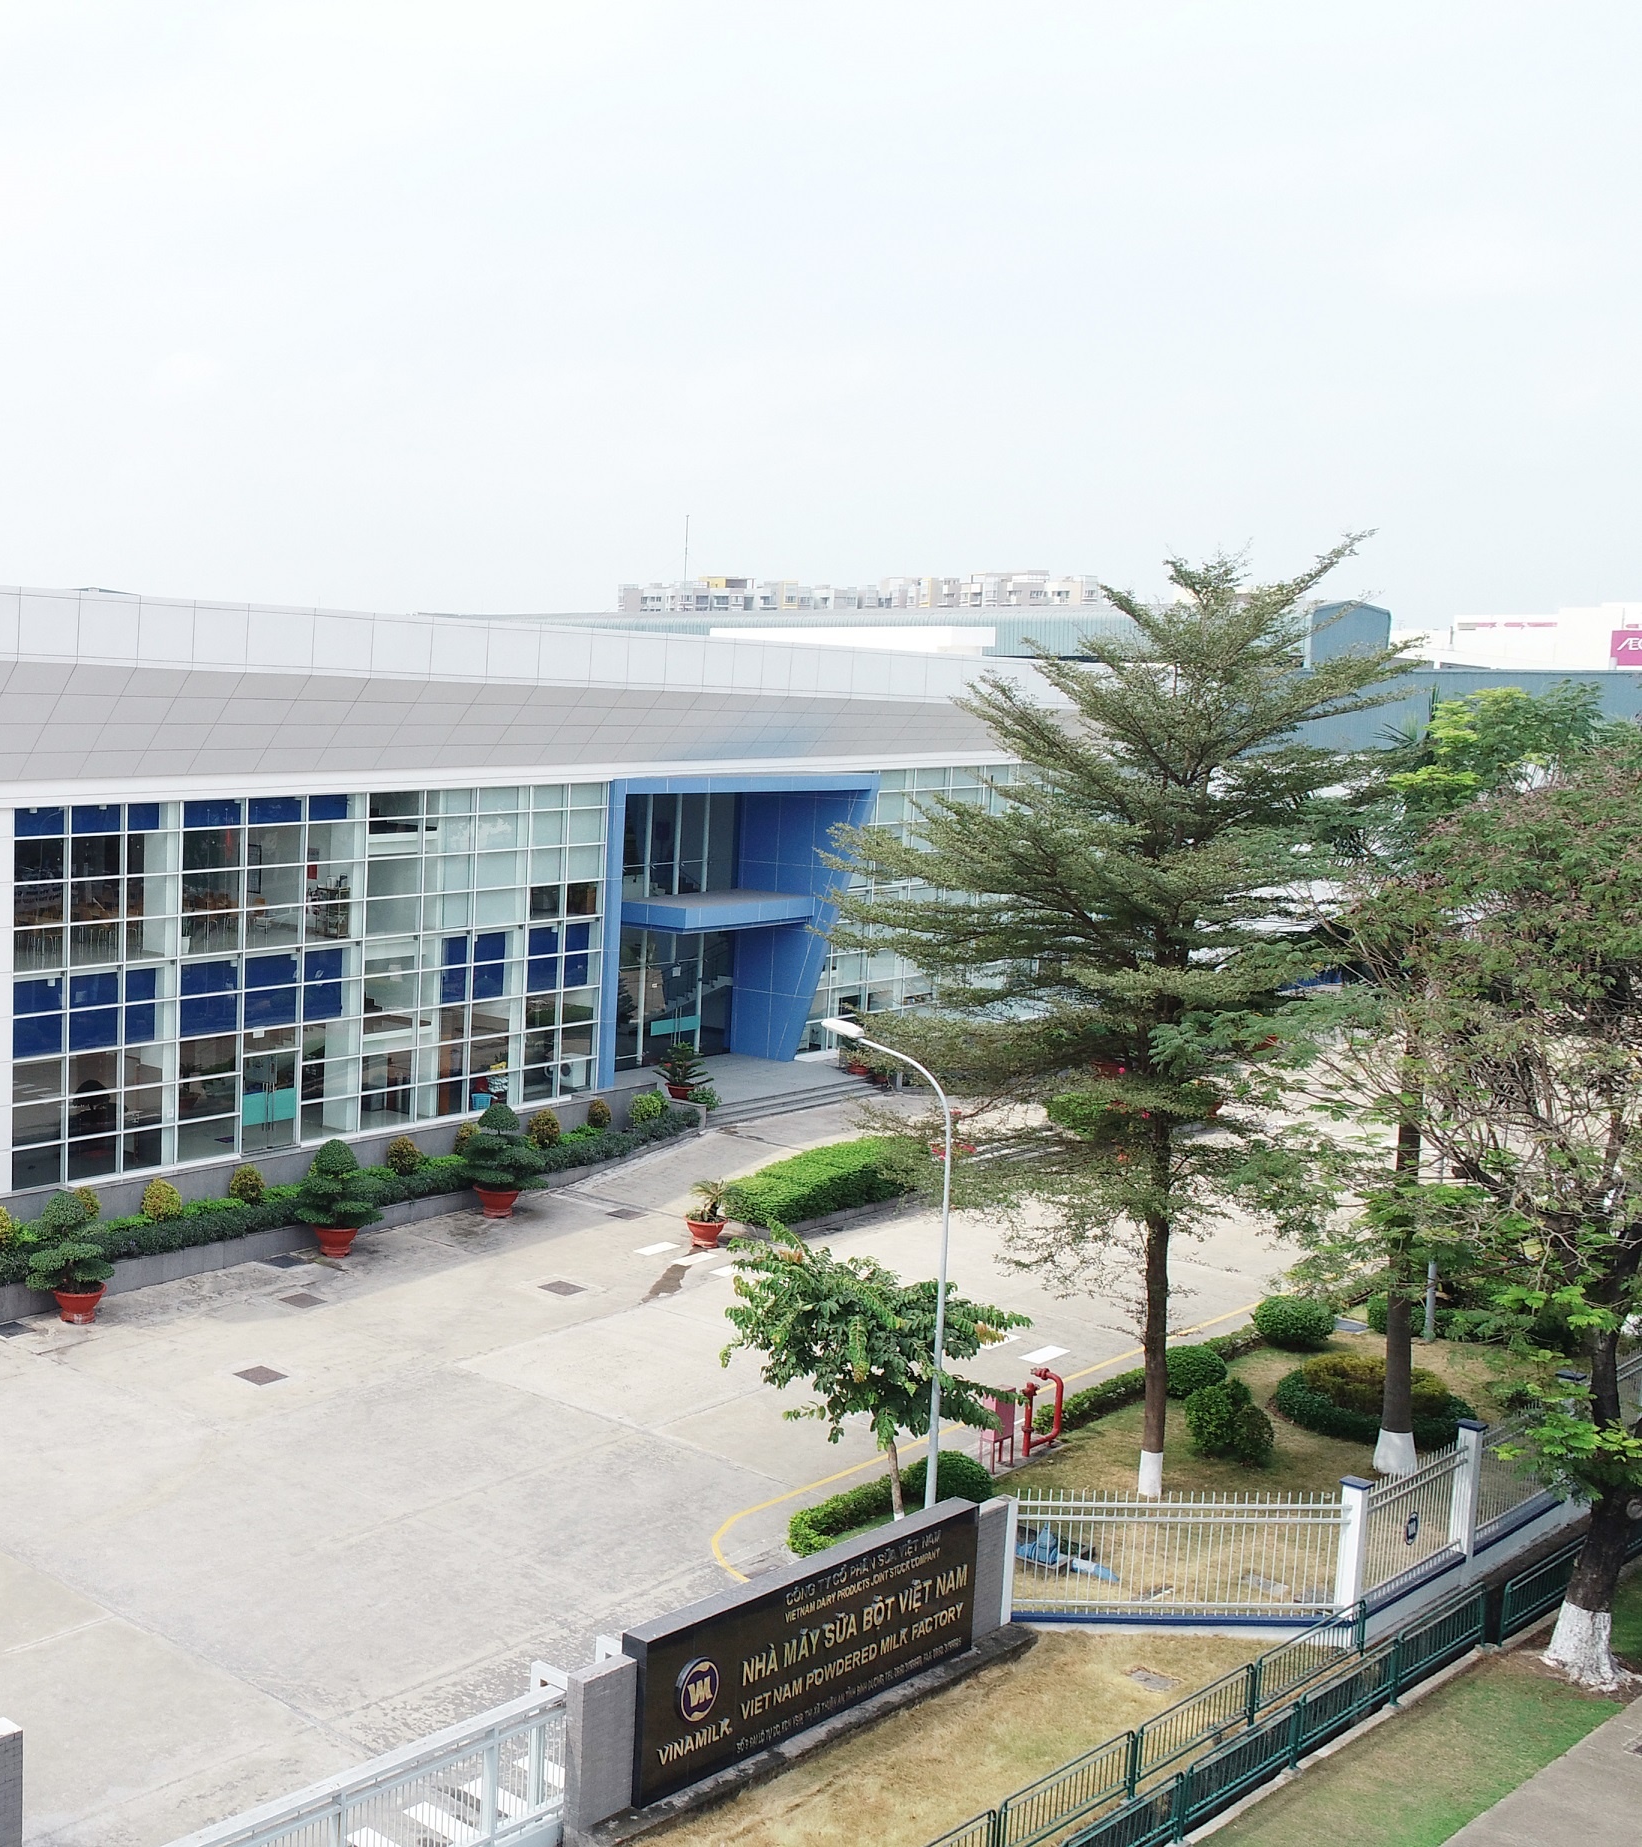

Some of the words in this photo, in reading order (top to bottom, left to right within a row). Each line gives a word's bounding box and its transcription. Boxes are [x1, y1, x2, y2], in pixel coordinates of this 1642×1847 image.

[784, 1601, 816, 1623] VIETNAM
[816, 1591, 836, 1610] DAIRY
[837, 1578, 870, 1600] PRODUCTS
[871, 1569, 889, 1586] JOINT
[889, 1560, 910, 1578] STOCK
[910, 1547, 940, 1569] COMPANY
[818, 1575, 831, 1592] TY
[742, 1643, 779, 1687] NHÀ
[822, 1612, 858, 1648] SỮA
[862, 1594, 895, 1631] BỘT
[899, 1579, 932, 1614] VIỆT
[935, 1564, 968, 1598] NAM
[805, 1643, 878, 1691] POWDERED
[880, 1627, 908, 1655] MILK
[911, 1601, 964, 1640] FACTORY
